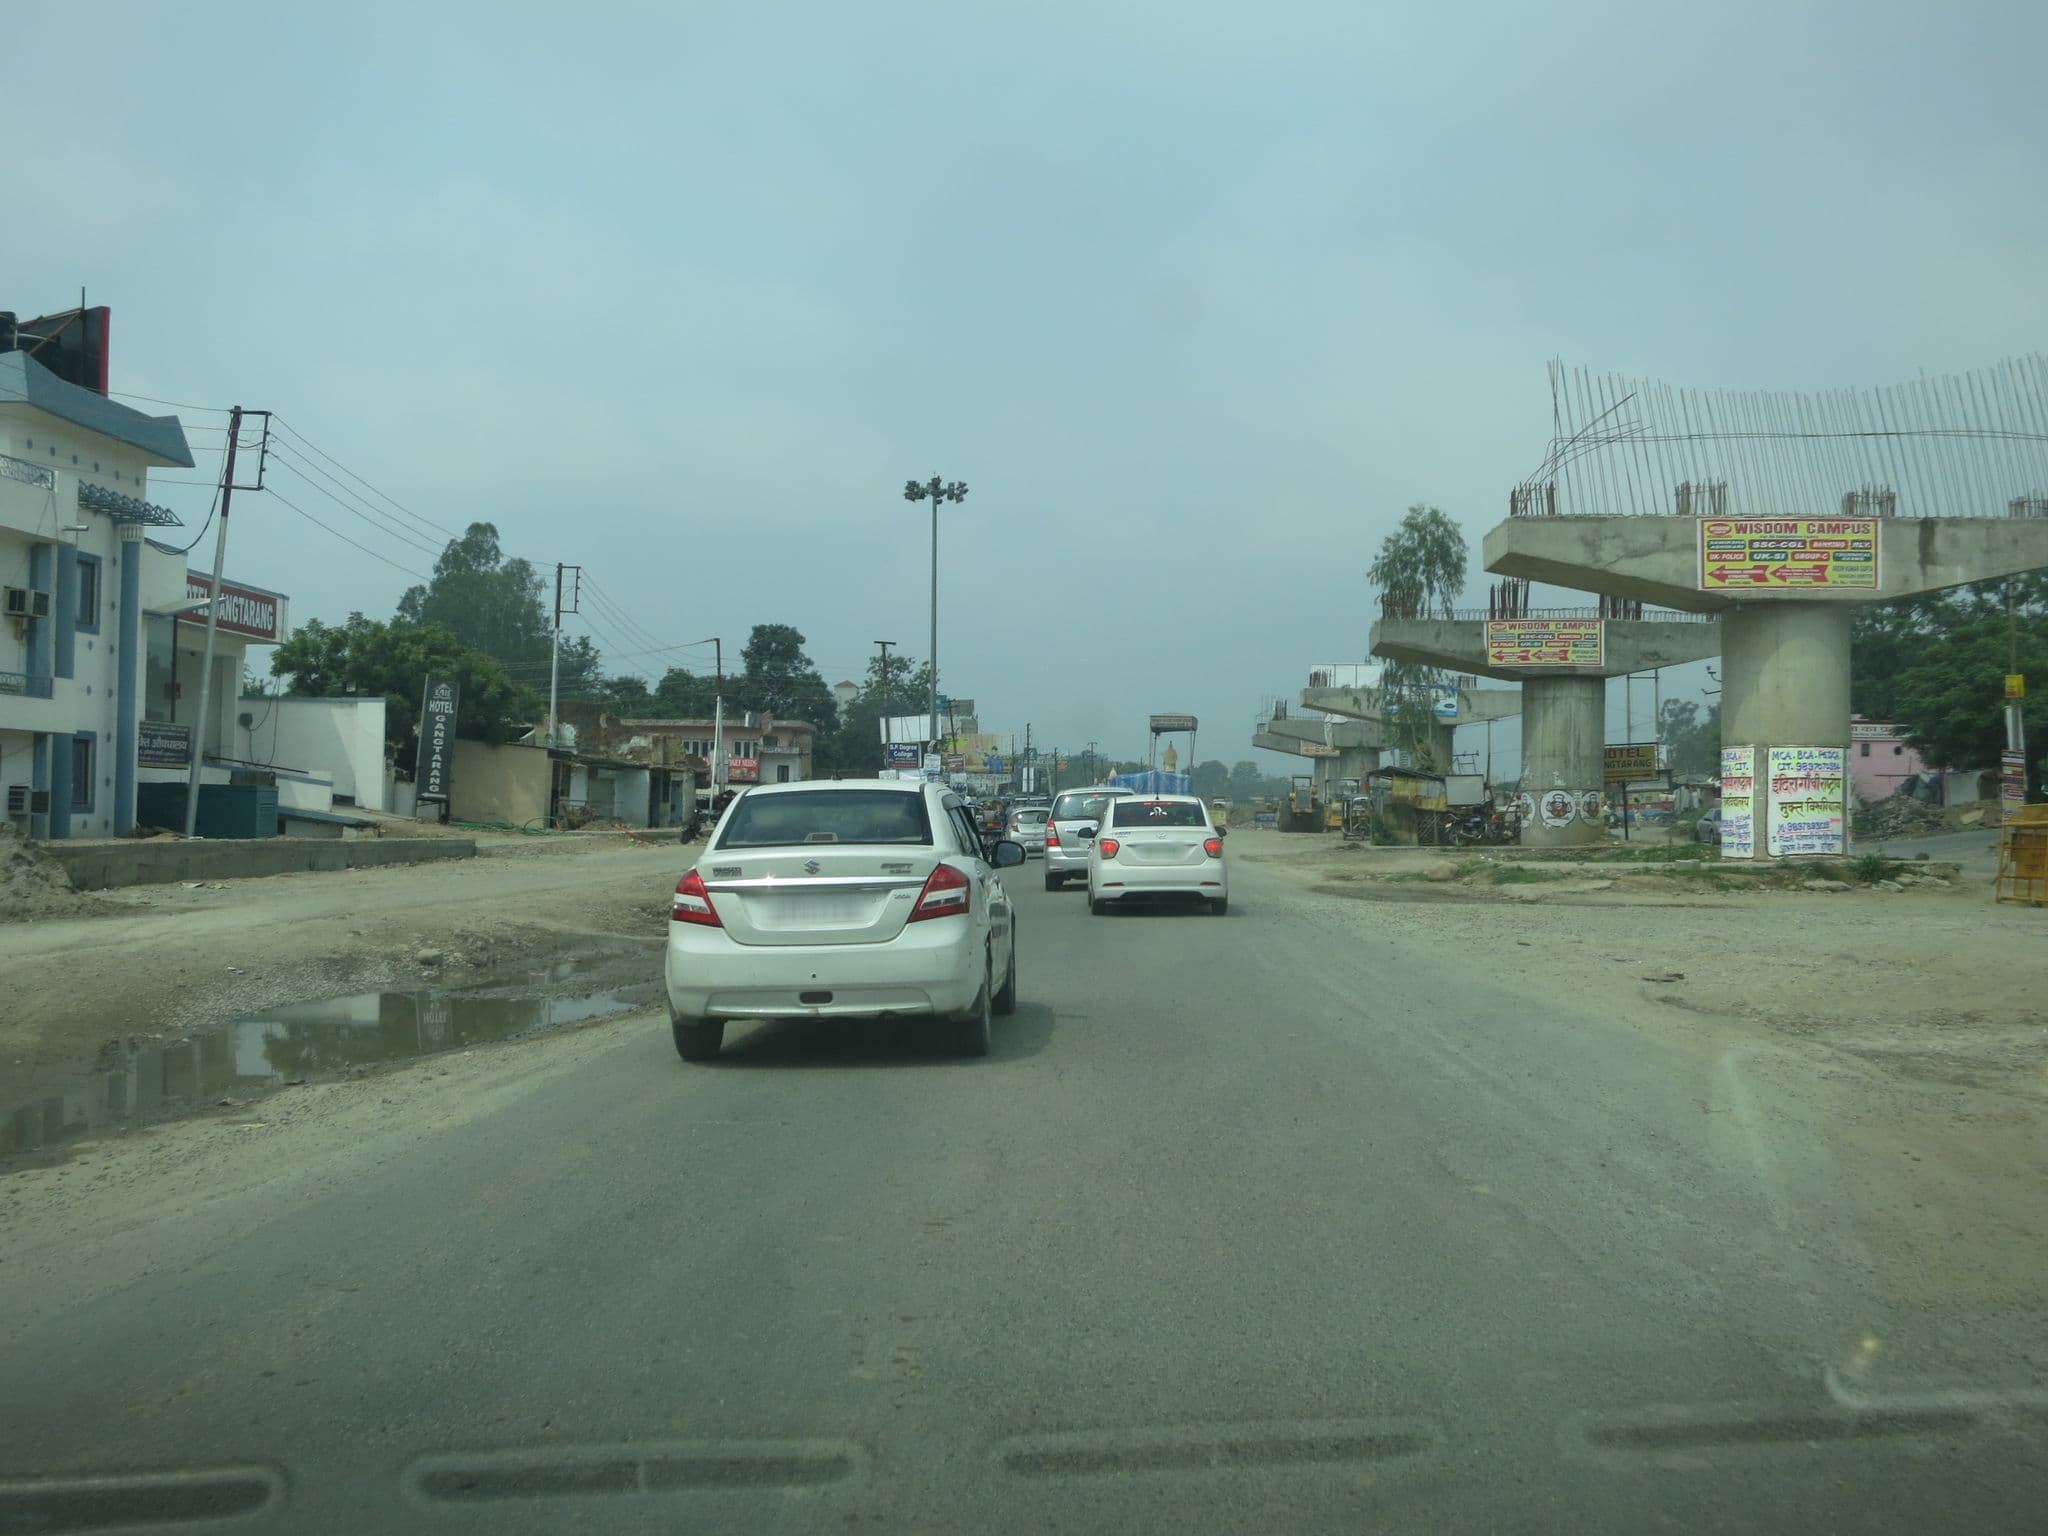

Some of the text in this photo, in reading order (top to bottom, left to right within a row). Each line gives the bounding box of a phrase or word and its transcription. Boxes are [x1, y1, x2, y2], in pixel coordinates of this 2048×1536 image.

[1734, 522, 1798, 534] WISDOM
[1807, 522, 1871, 534] CAMPUS
[1751, 541, 1805, 549] SSC-CGL
[219, 592, 273, 631] ANGTARANG
[1508, 622, 1550, 630] WISDOM
[1555, 622, 1597, 630] CAMPUS
[429, 700, 454, 713] HOTEL
[428, 714, 447, 792] GANGTARANG
[1604, 760, 1652, 769] NGTARANG
